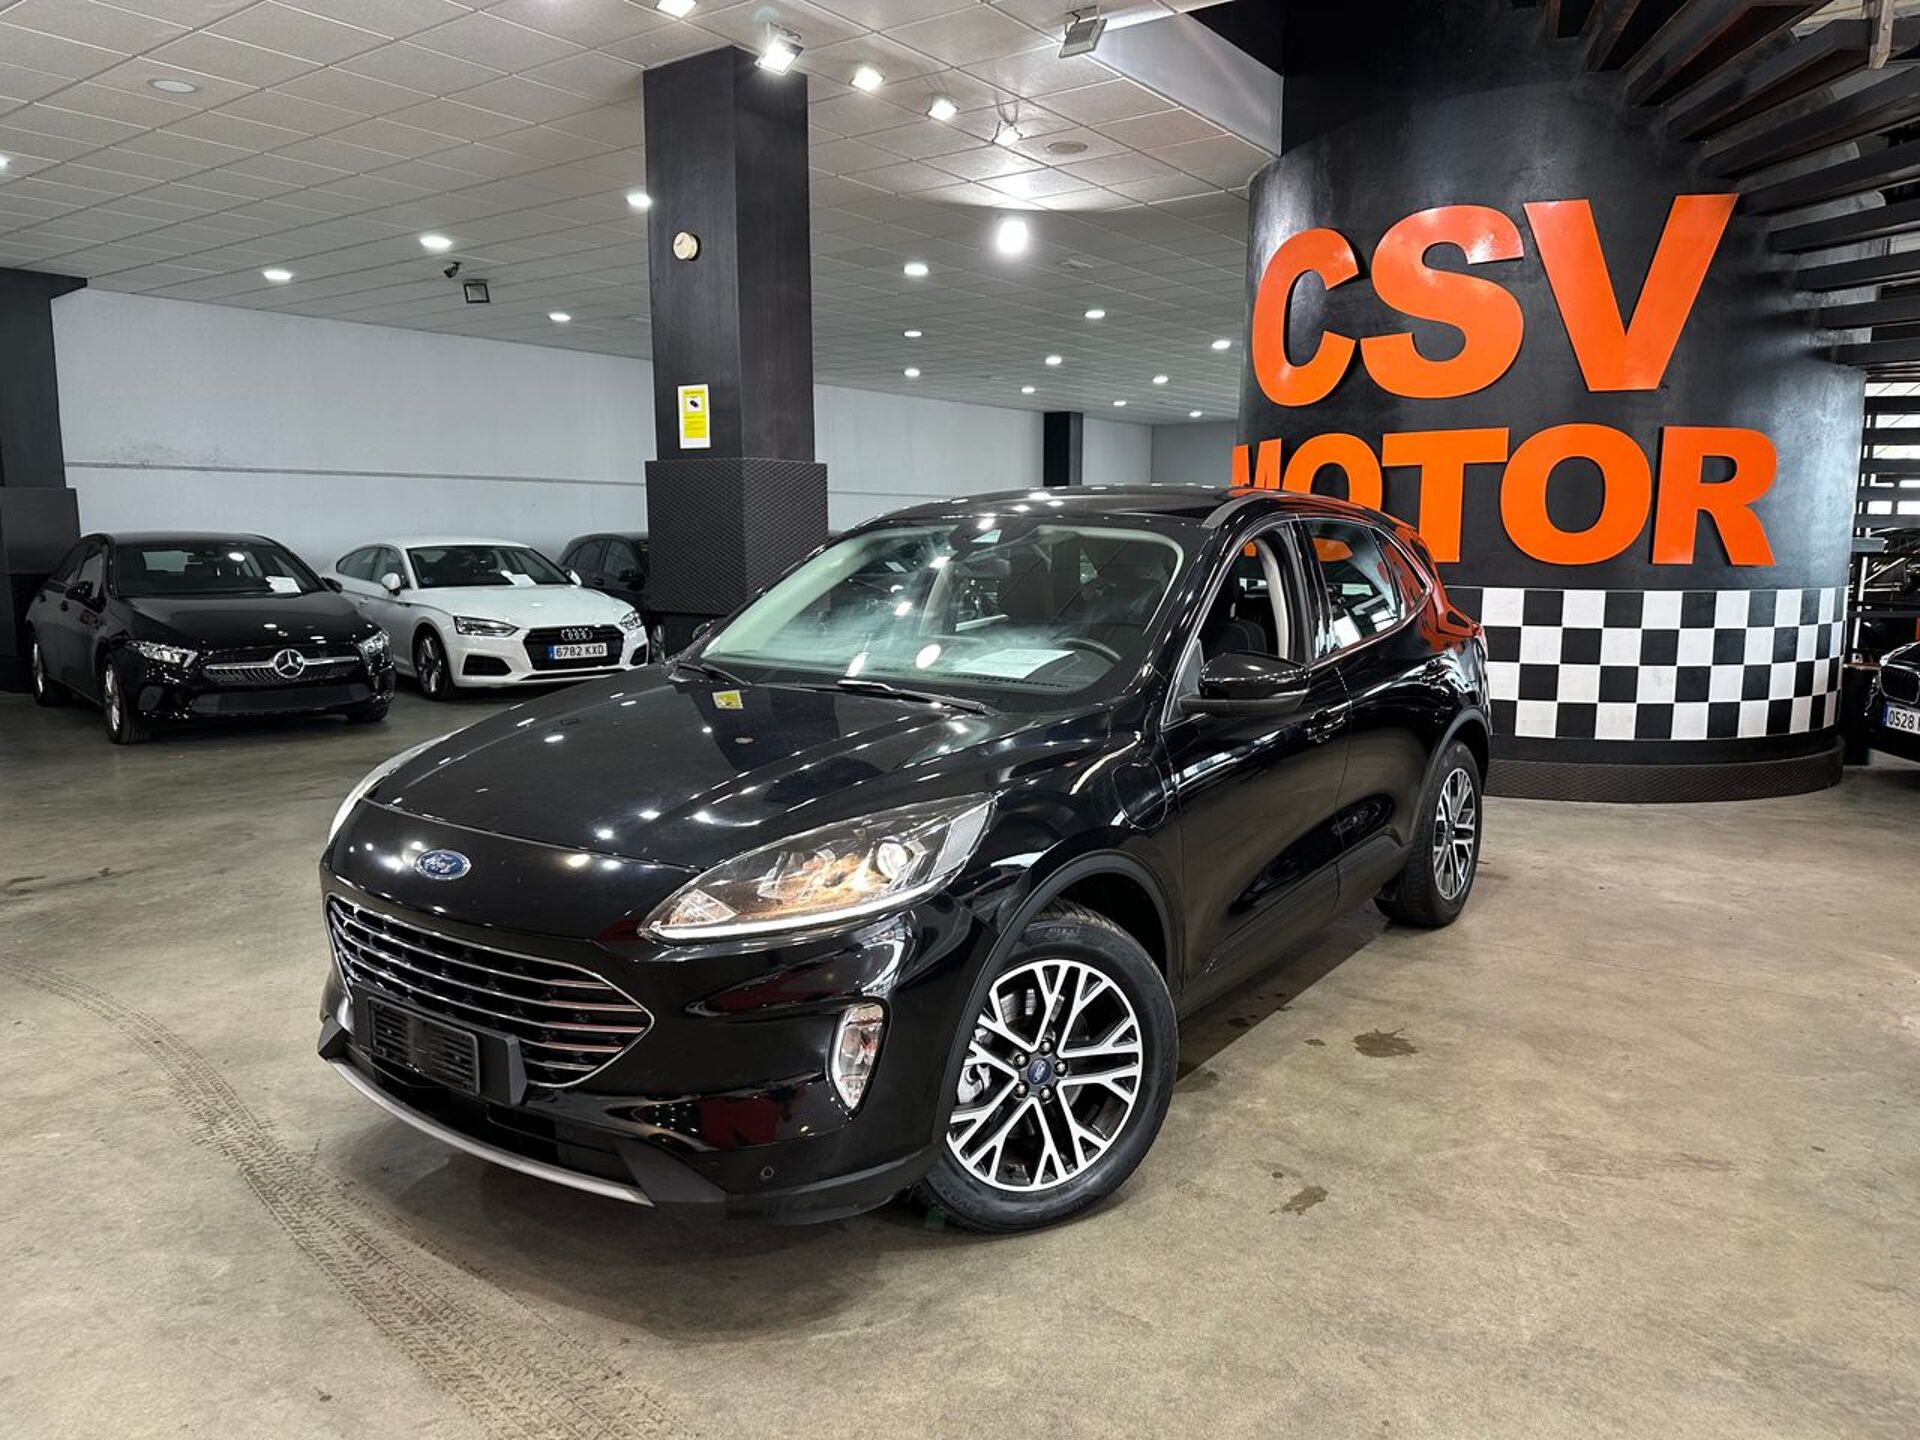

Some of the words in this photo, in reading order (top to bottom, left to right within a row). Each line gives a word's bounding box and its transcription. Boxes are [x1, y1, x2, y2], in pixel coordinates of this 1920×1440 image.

[1252, 192, 1739, 407] CSV
[556, 646, 582, 658] 6782
[1889, 710, 1915, 730] 0528
